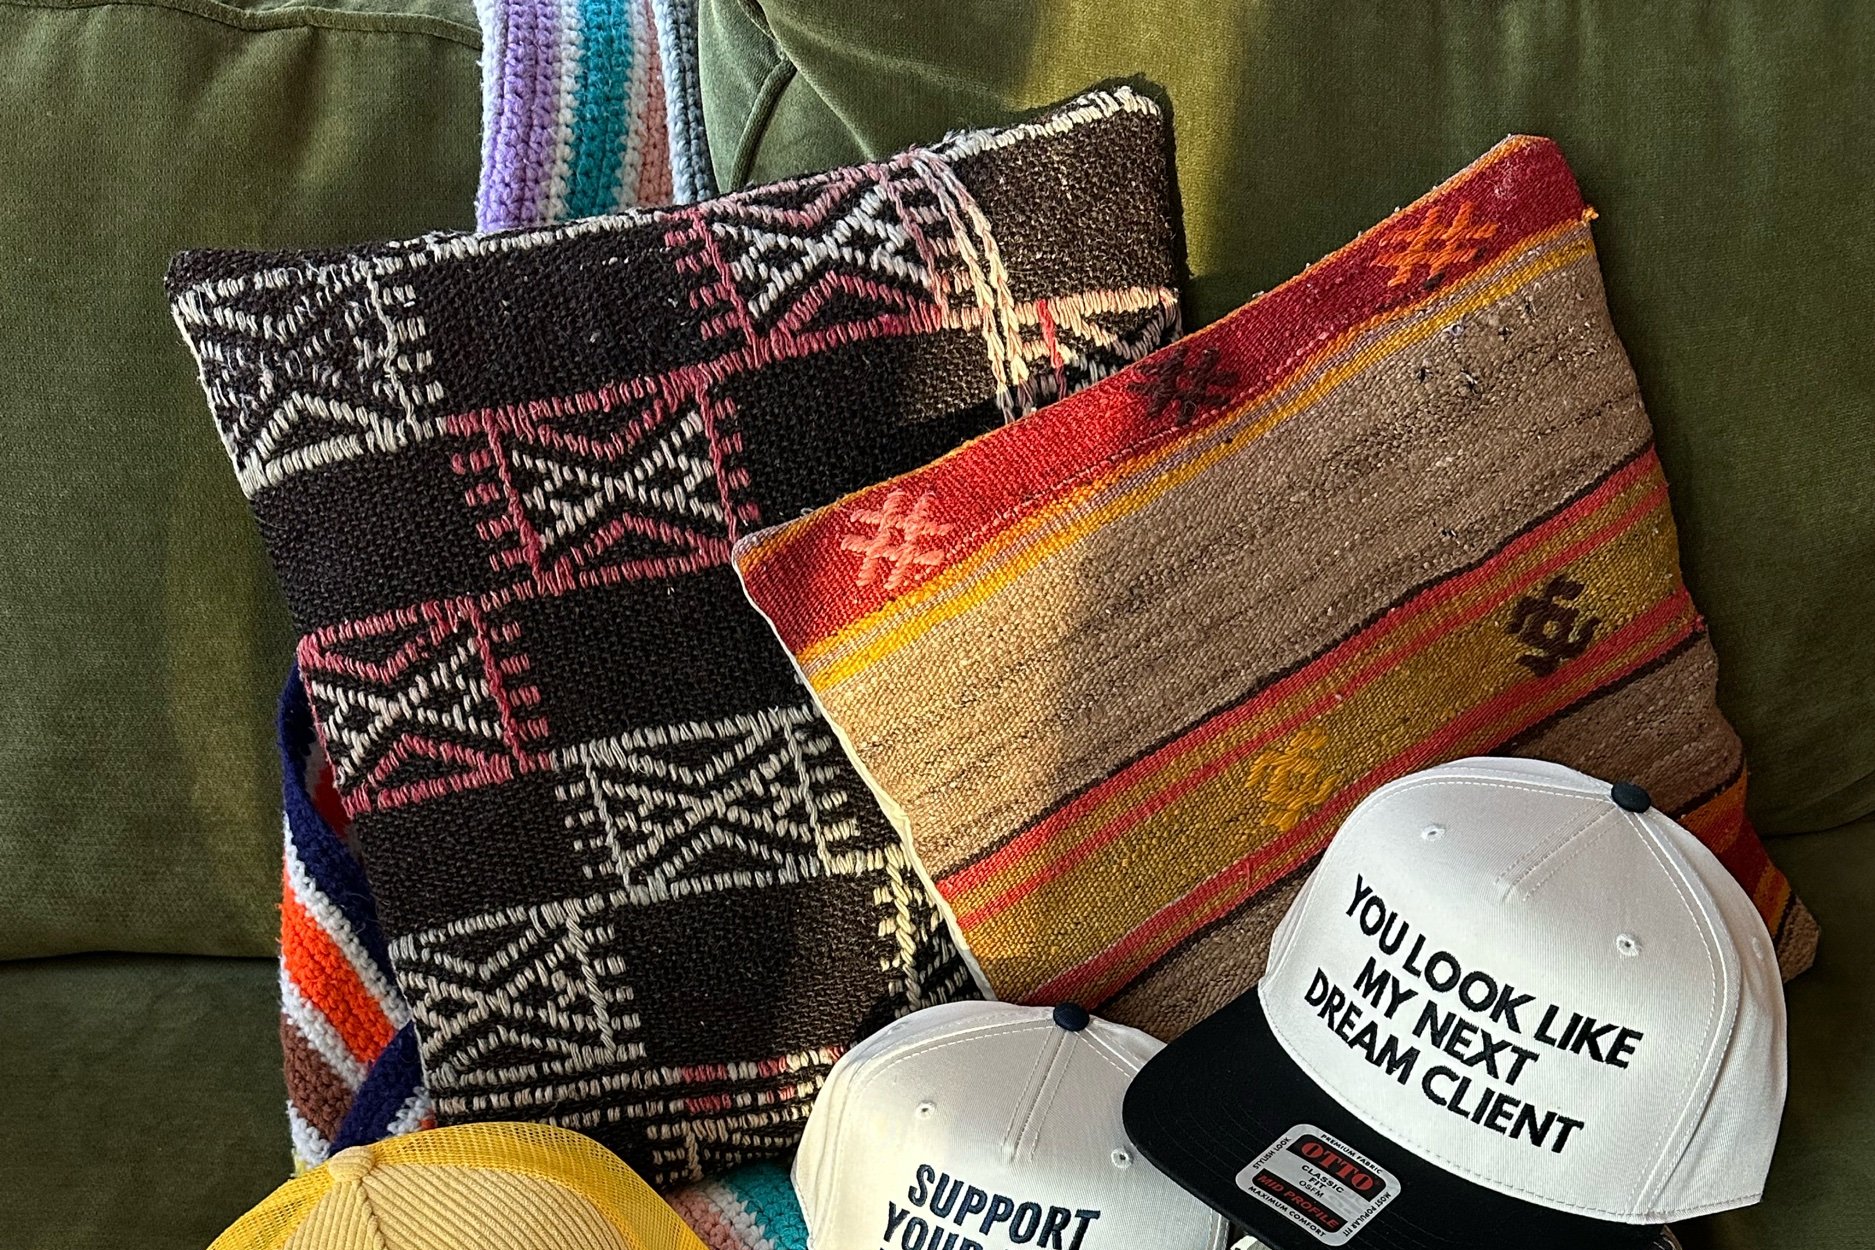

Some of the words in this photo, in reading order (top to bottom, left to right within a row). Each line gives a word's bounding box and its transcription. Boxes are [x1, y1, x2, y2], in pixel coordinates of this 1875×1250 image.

[1346, 873, 1409, 956] YOU
[1402, 933, 1536, 1034] LOOK
[1533, 1004, 1644, 1069] LIKE
[1353, 956, 1419, 1019] MY
[1412, 1000, 1540, 1086] NEXT
[1304, 967, 1420, 1086] DREAM
[1422, 1065, 1584, 1154] CLIENT
[1253, 1149, 1275, 1169] STYLISH
[1276, 1137, 1291, 1152] LOOK
[1302, 1142, 1373, 1190] OTTO
[1321, 1134, 1355, 1157] PREMIUM
[1356, 1155, 1383, 1174] FABRIC
[1299, 1180, 1324, 1198] OSFM
[1302, 1165, 1344, 1193] CLASSIC
[1308, 1177, 1326, 1189] FIT
[1248, 1186, 1288, 1212] MAXIMUM
[1289, 1210, 1326, 1238] COMFORT
[1258, 1175, 1284, 1192] MID
[1284, 1192, 1340, 1228] PROFILE
[1352, 1206, 1376, 1230] POPULAR
[1376, 1192, 1391, 1208] MOST
